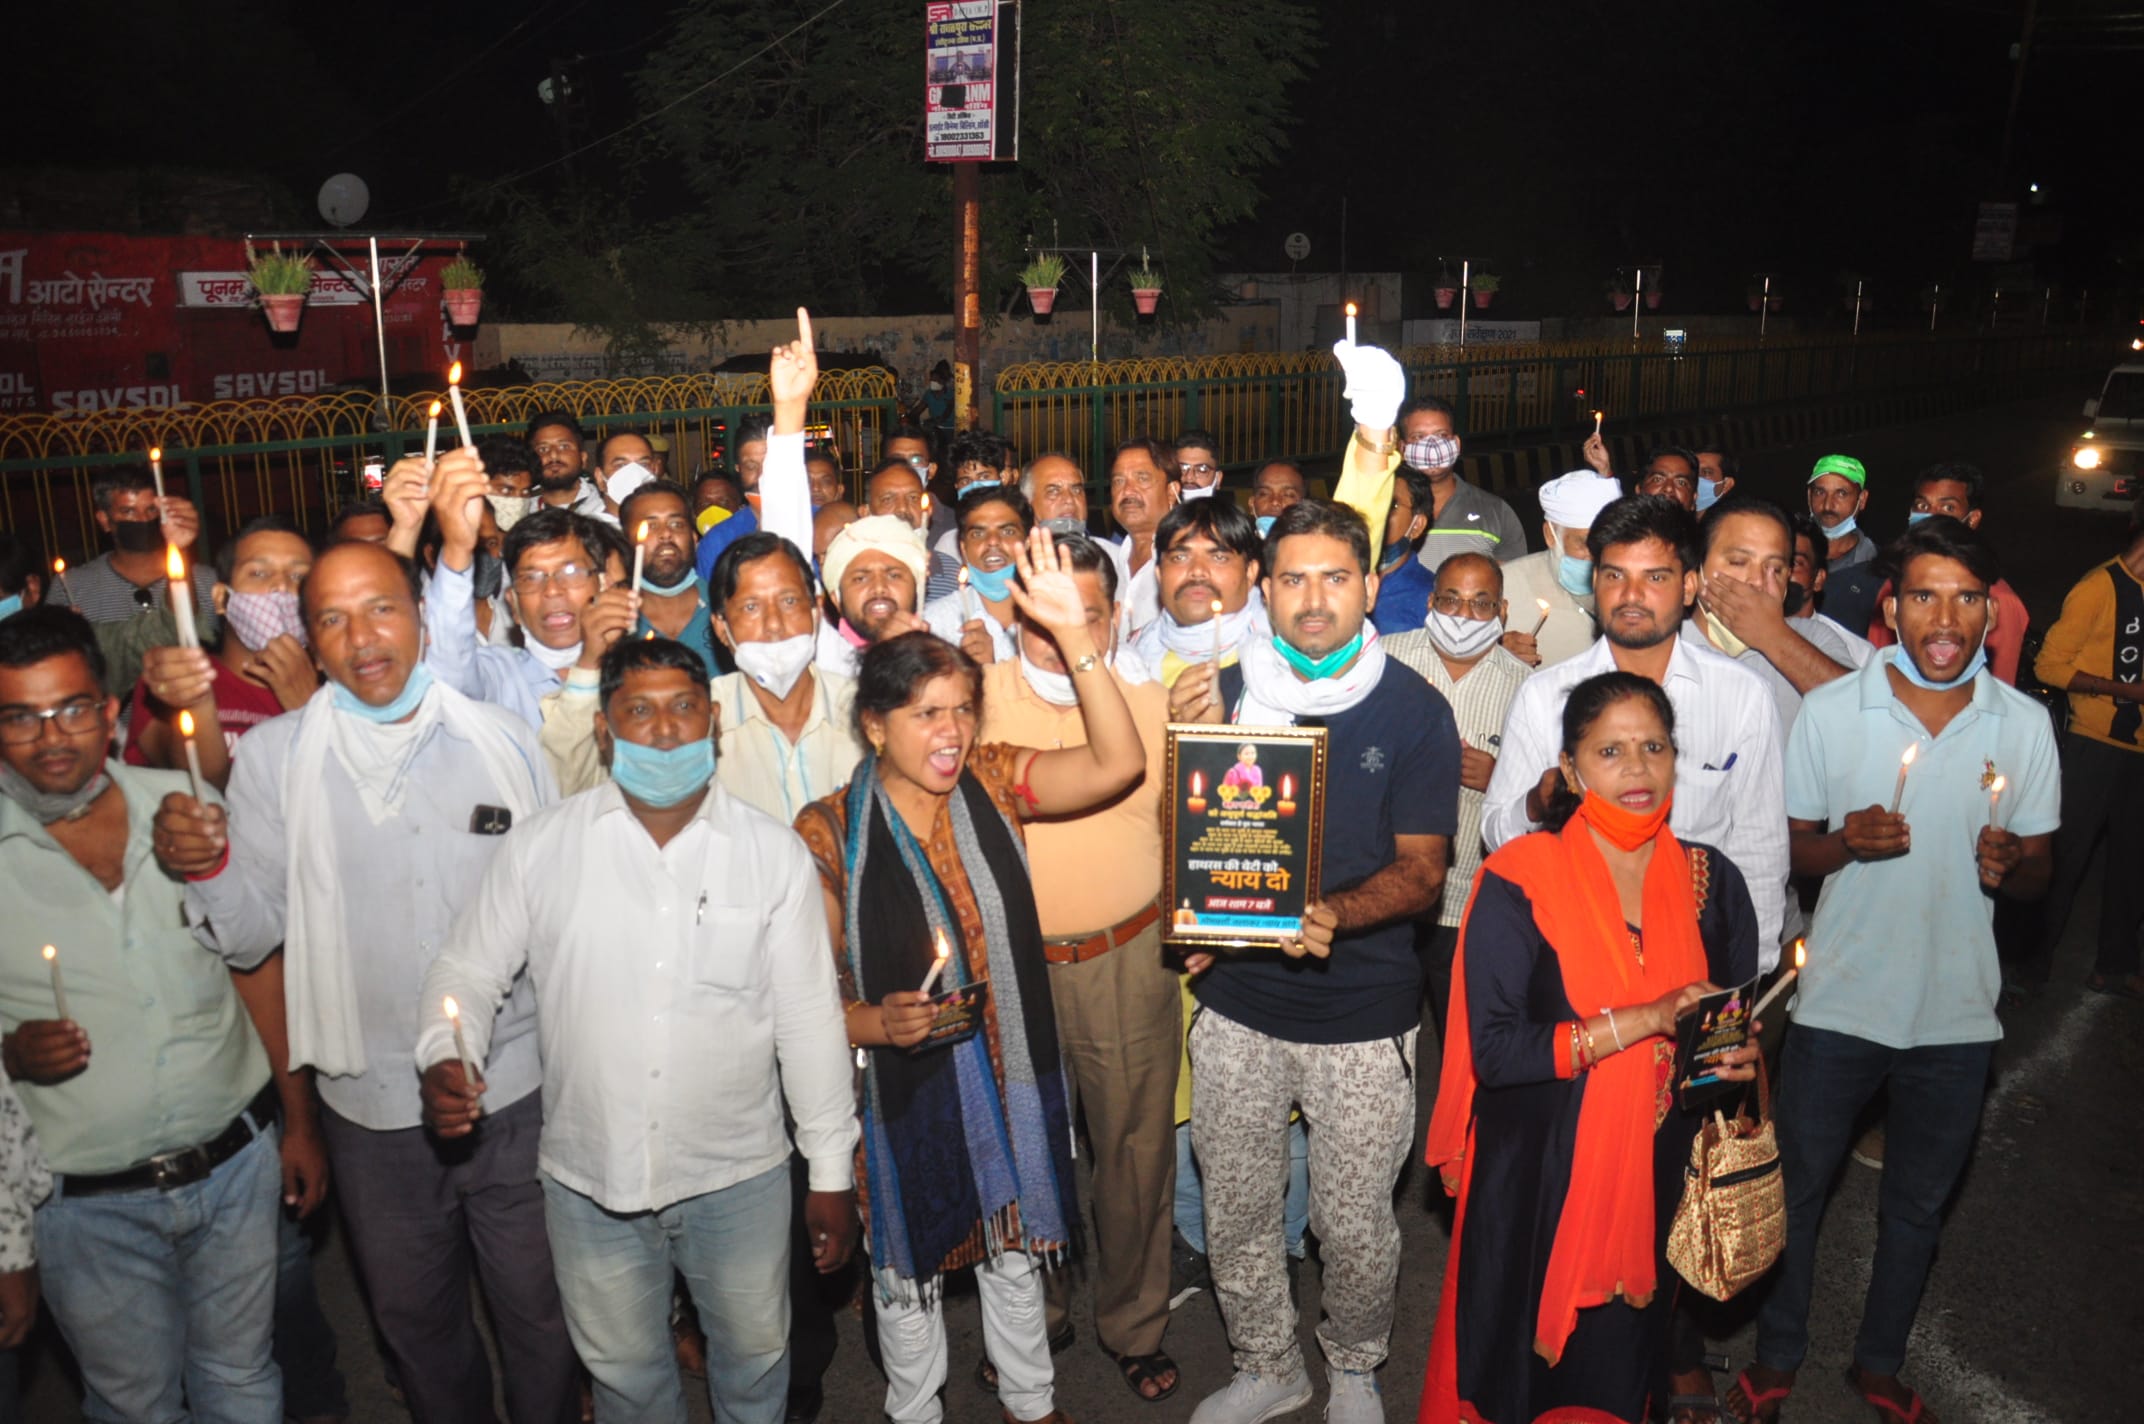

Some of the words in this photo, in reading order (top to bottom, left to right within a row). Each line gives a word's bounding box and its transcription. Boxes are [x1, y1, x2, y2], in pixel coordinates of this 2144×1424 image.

[27, 270, 85, 305] आटो
[87, 272, 155, 310] सेन्टर
[197, 279, 244, 303] पूनम
[1498, 329, 1517, 340] 2021
[214, 369, 335, 399] SAVSOL
[51, 384, 192, 419] SAVSOL
[1188, 859, 1222, 871] हाथरस
[1224, 858, 1240, 871] की
[1241, 859, 1261, 872] बेटी
[1262, 860, 1279, 873] को
[1209, 870, 1263, 890] न्याय
[1264, 867, 1291, 892] दो
[1248, 900, 1256, 909] 7
